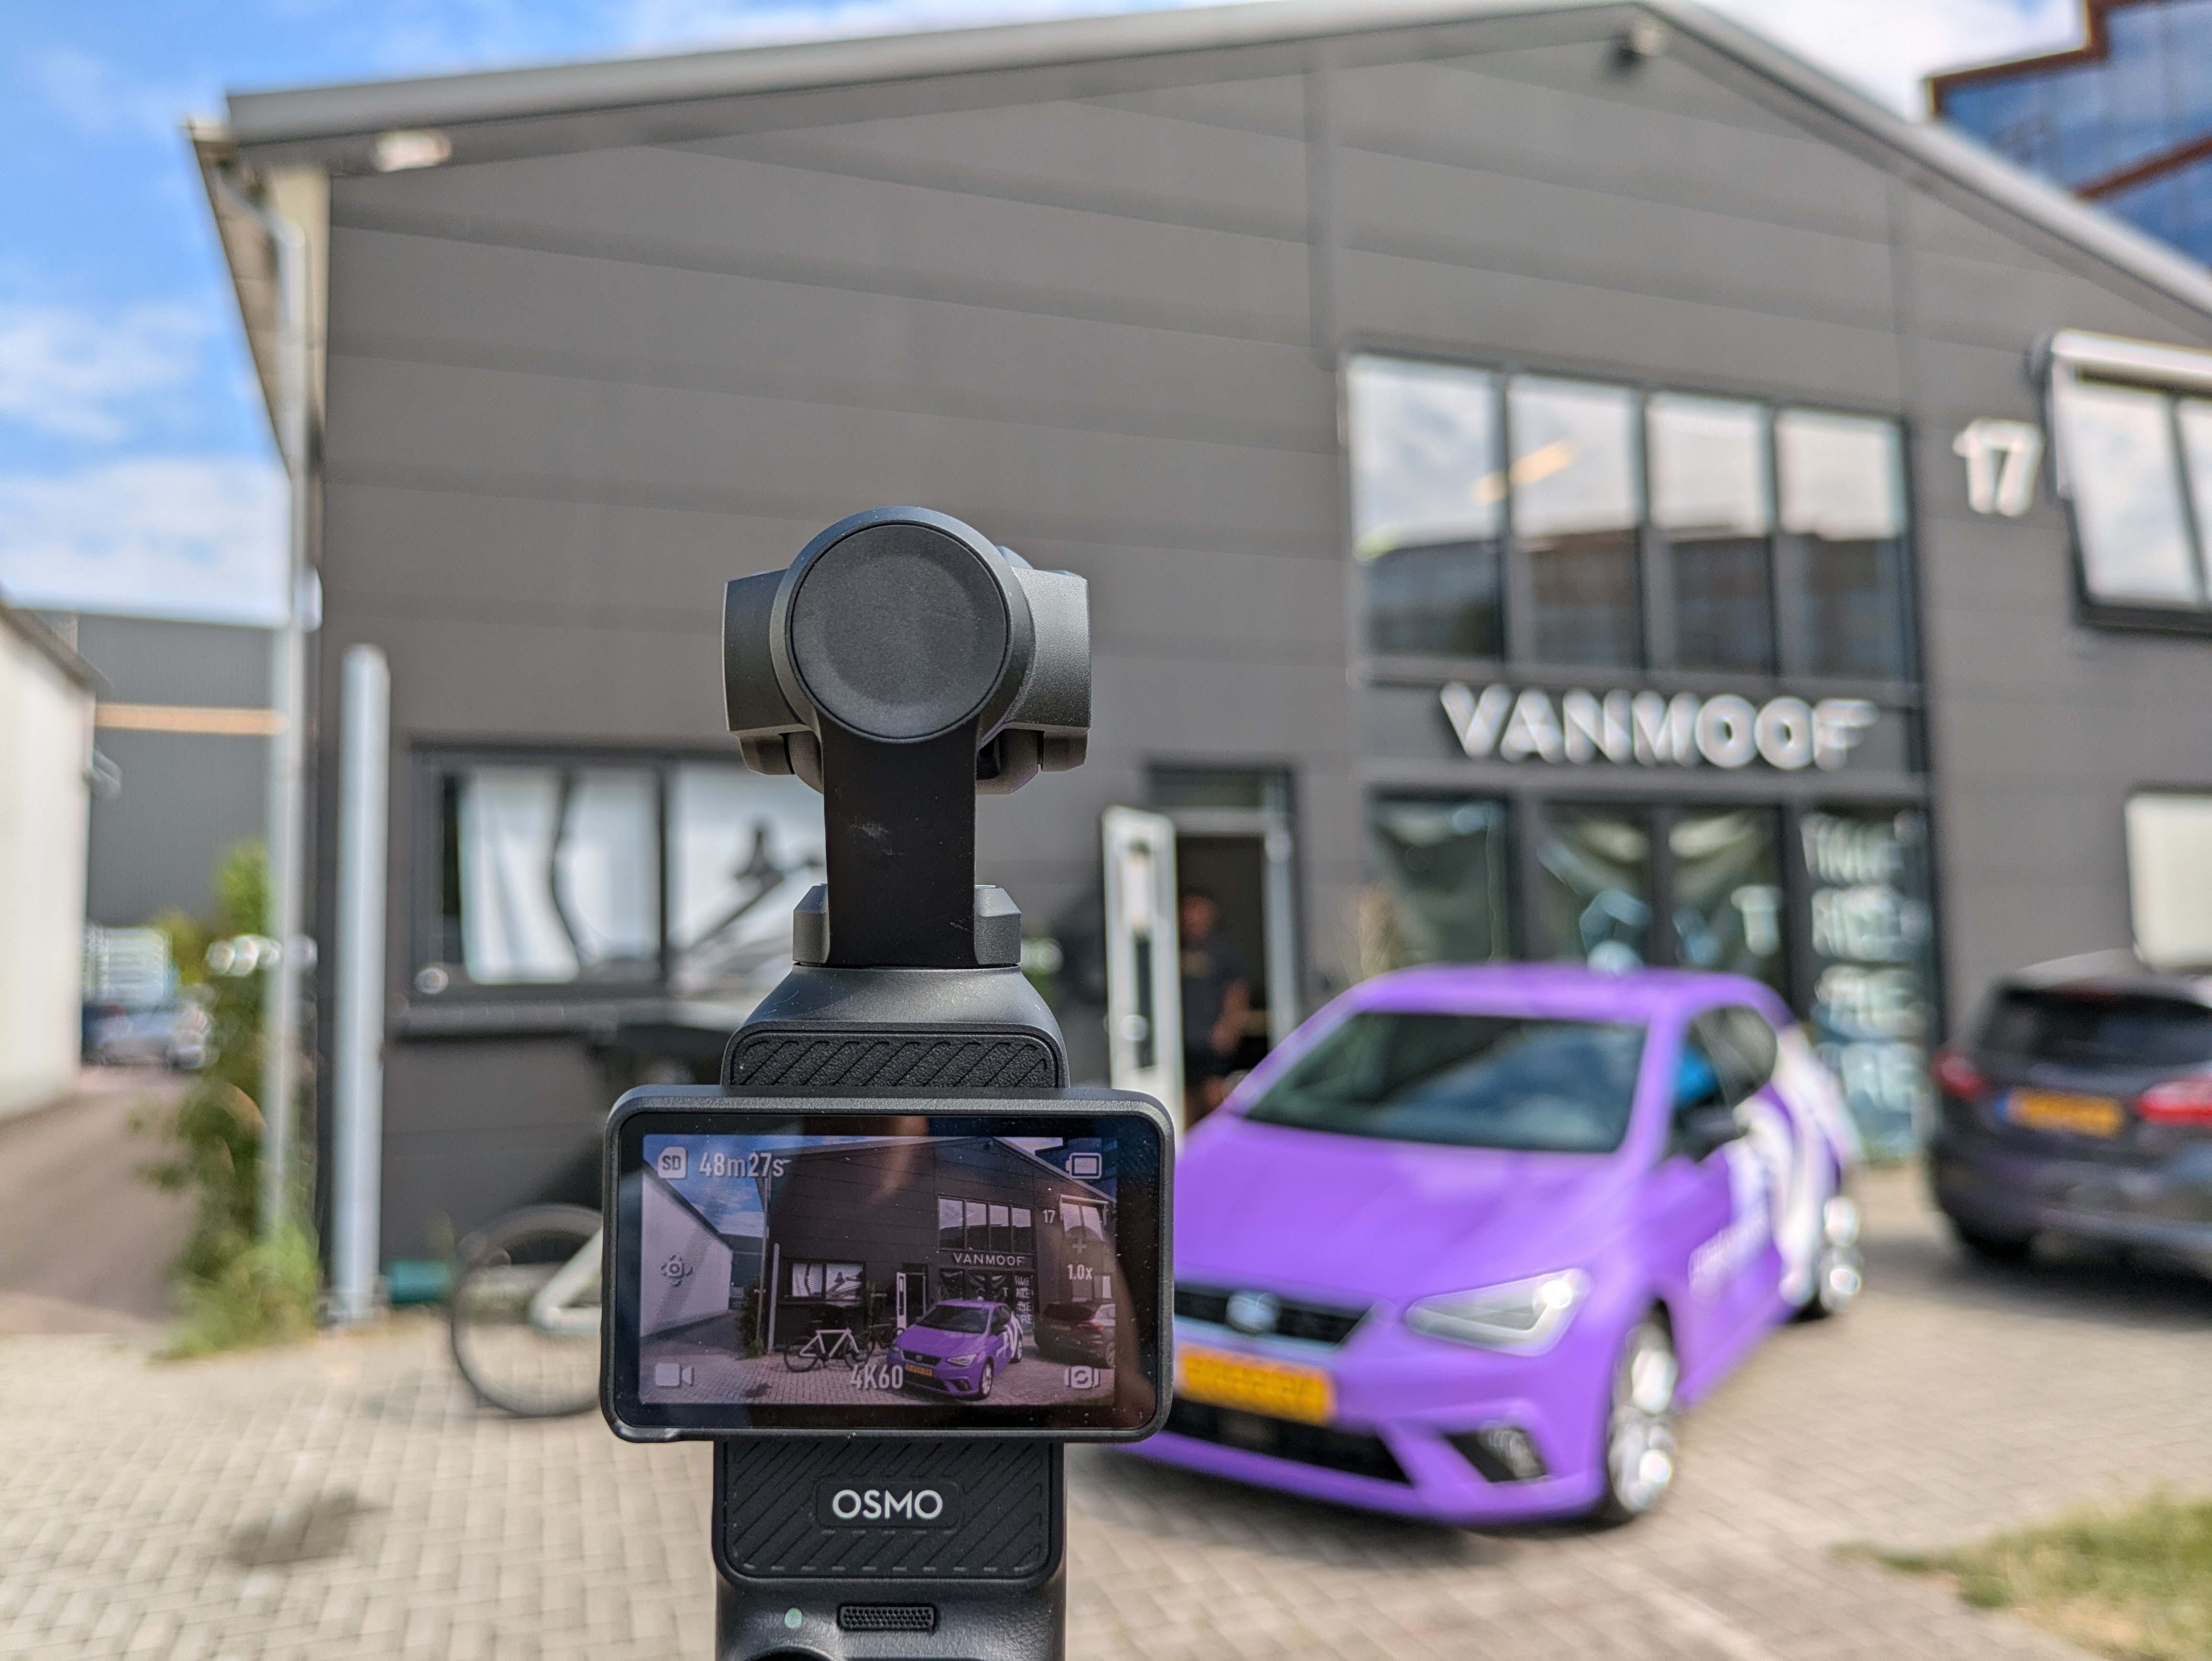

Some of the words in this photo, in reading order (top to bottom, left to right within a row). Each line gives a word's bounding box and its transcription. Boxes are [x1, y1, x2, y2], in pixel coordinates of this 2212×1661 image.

[1952, 416, 2045, 517] 17
[1440, 682, 1878, 768] VANMOOF
[662, 1154, 681, 1171] SD
[700, 1152, 784, 1177] 48m27s
[952, 1251, 1025, 1267] VANMOOF
[1067, 1264, 1093, 1280] 1.0x
[851, 1364, 903, 1389] 4K60
[832, 1489, 943, 1520] OSMO
